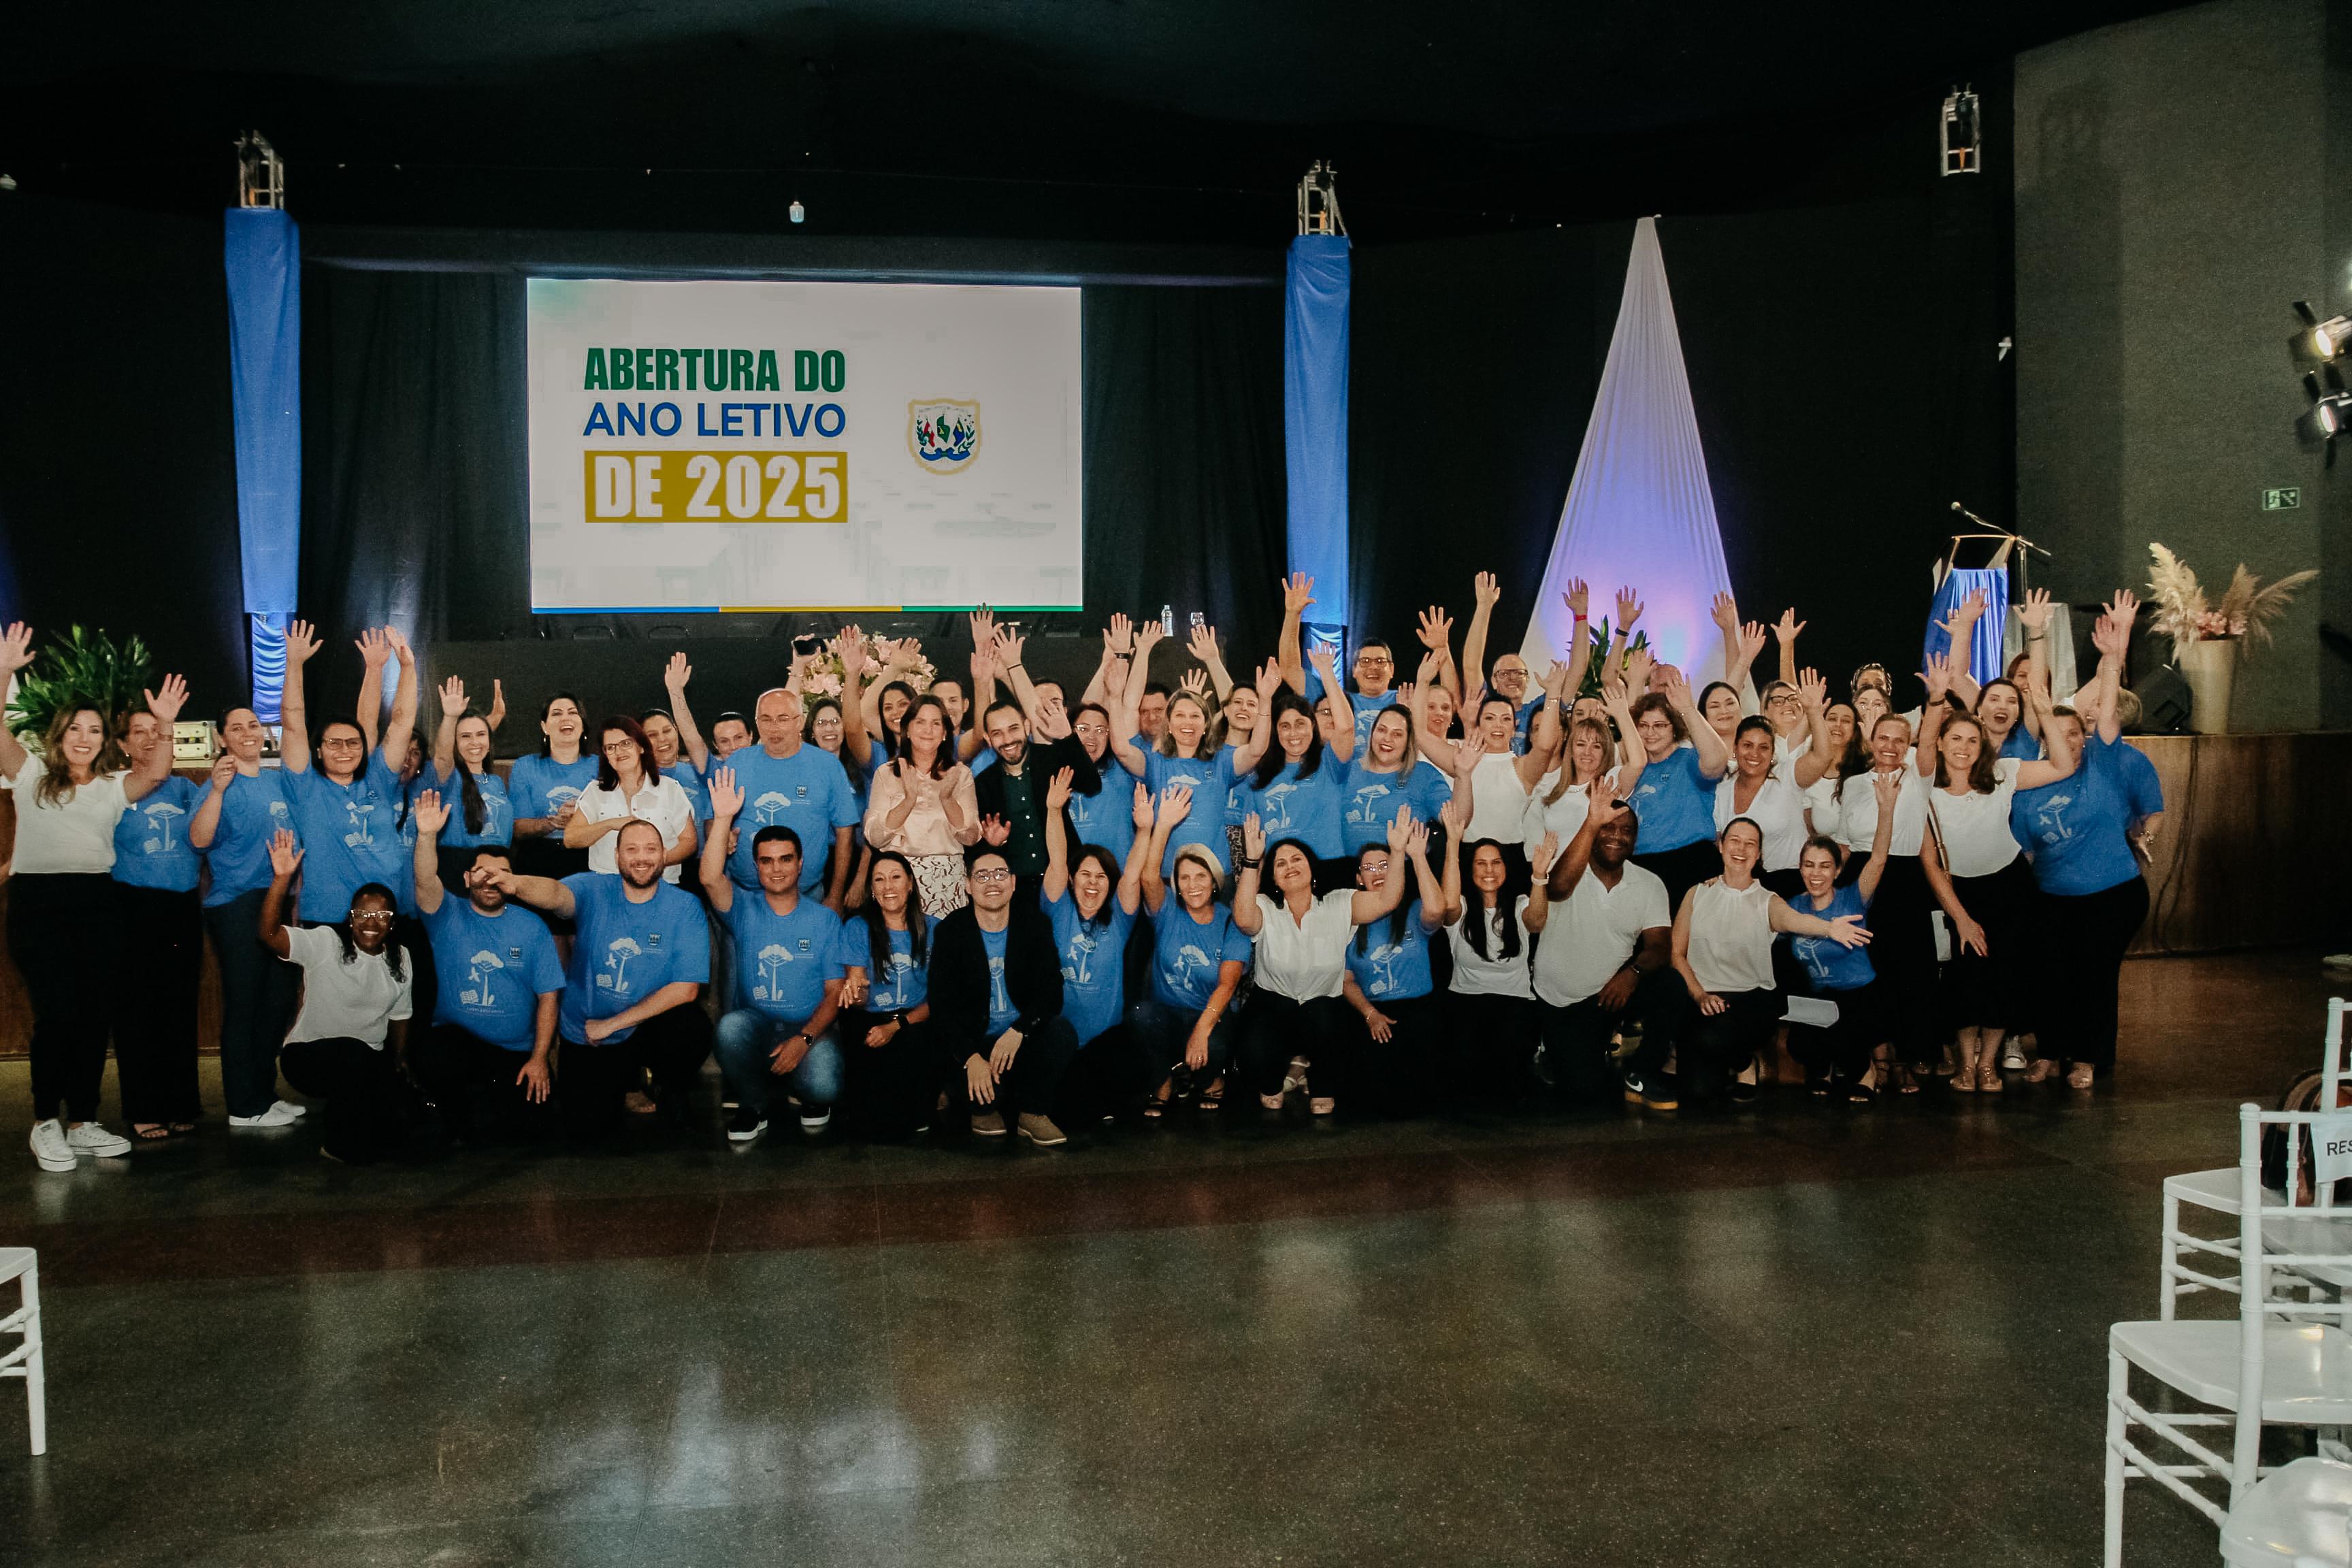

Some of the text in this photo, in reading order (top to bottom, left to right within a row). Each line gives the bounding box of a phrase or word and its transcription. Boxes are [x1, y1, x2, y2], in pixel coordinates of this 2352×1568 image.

[584, 348, 846, 392] ABERTURA DO
[584, 402, 846, 438] ANO LETIVO
[594, 455, 840, 519] DE 2025
